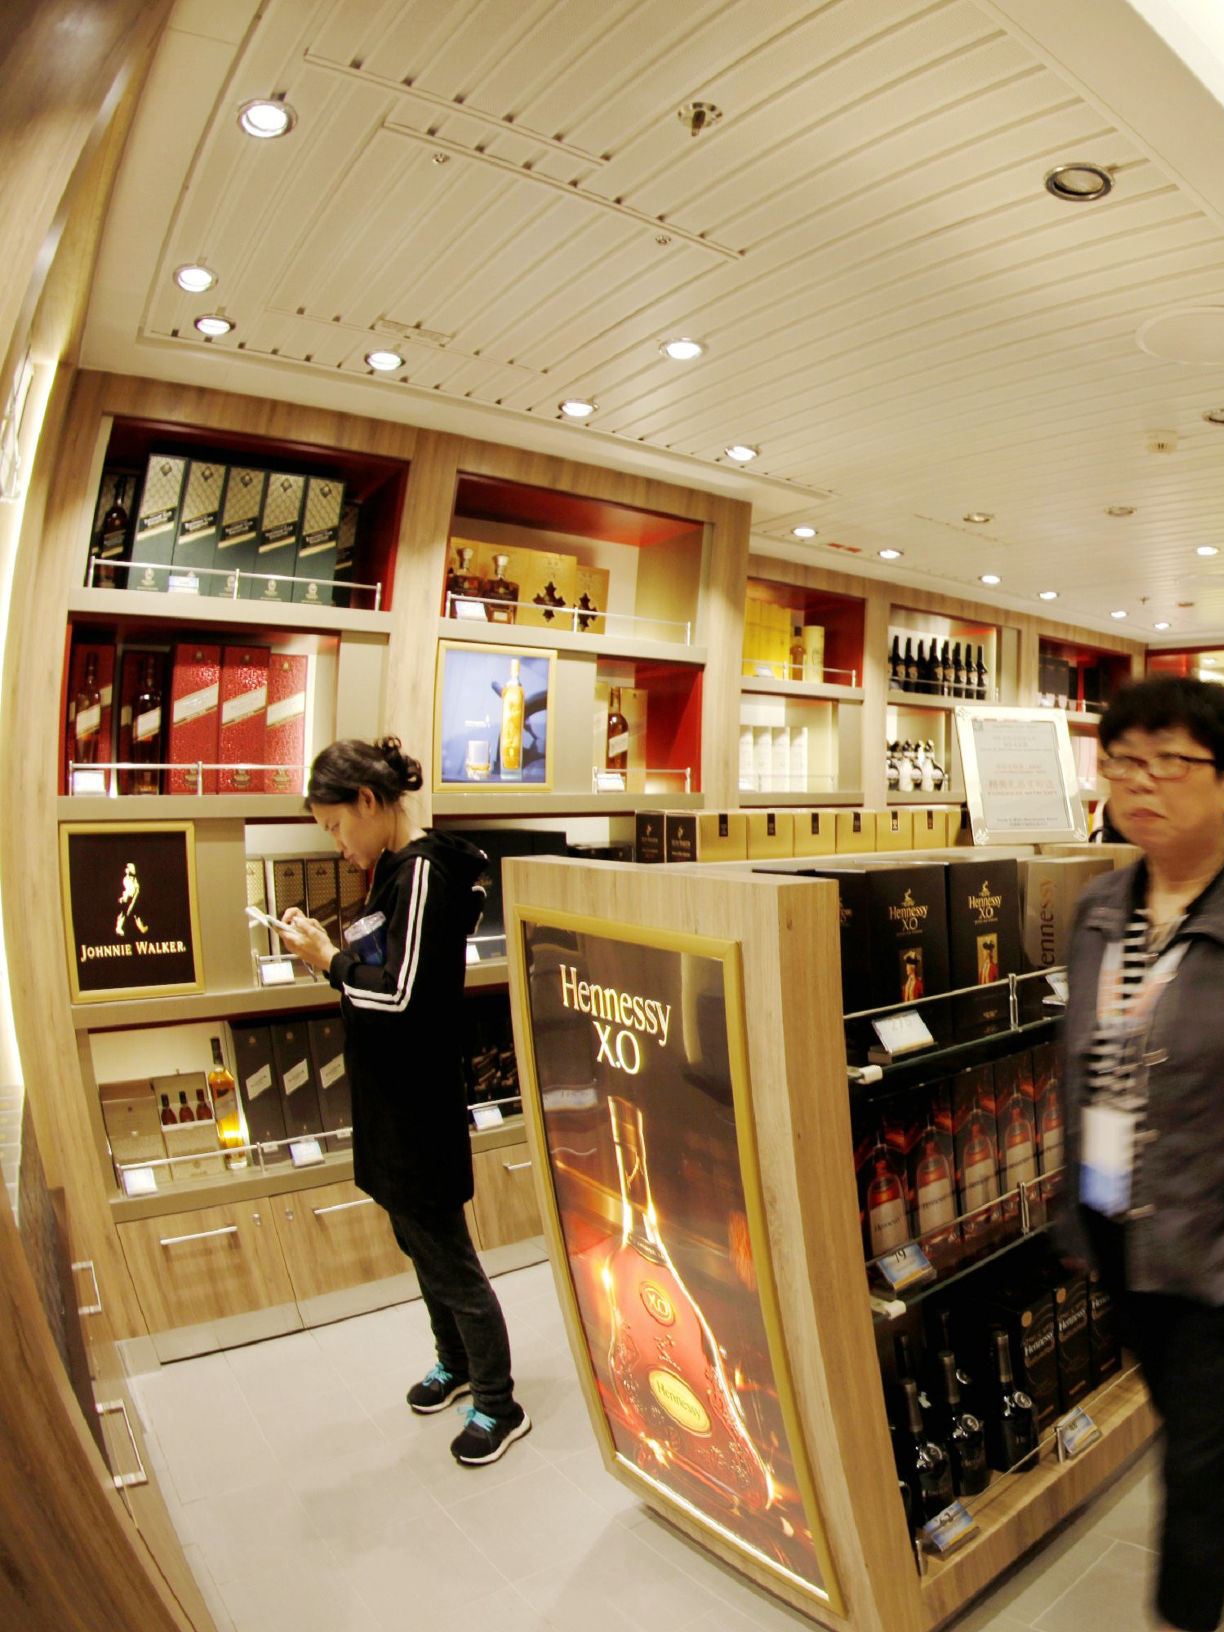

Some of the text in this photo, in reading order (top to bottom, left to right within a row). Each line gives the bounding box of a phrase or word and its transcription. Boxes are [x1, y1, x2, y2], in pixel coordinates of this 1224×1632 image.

[888, 905, 929, 919] Hennessy
[1039, 876, 1057, 971] ennessy
[81, 944, 132, 962] JOHNNIE
[559, 964, 671, 1047] Hennessy
[592, 1020, 641, 1075] X.O
